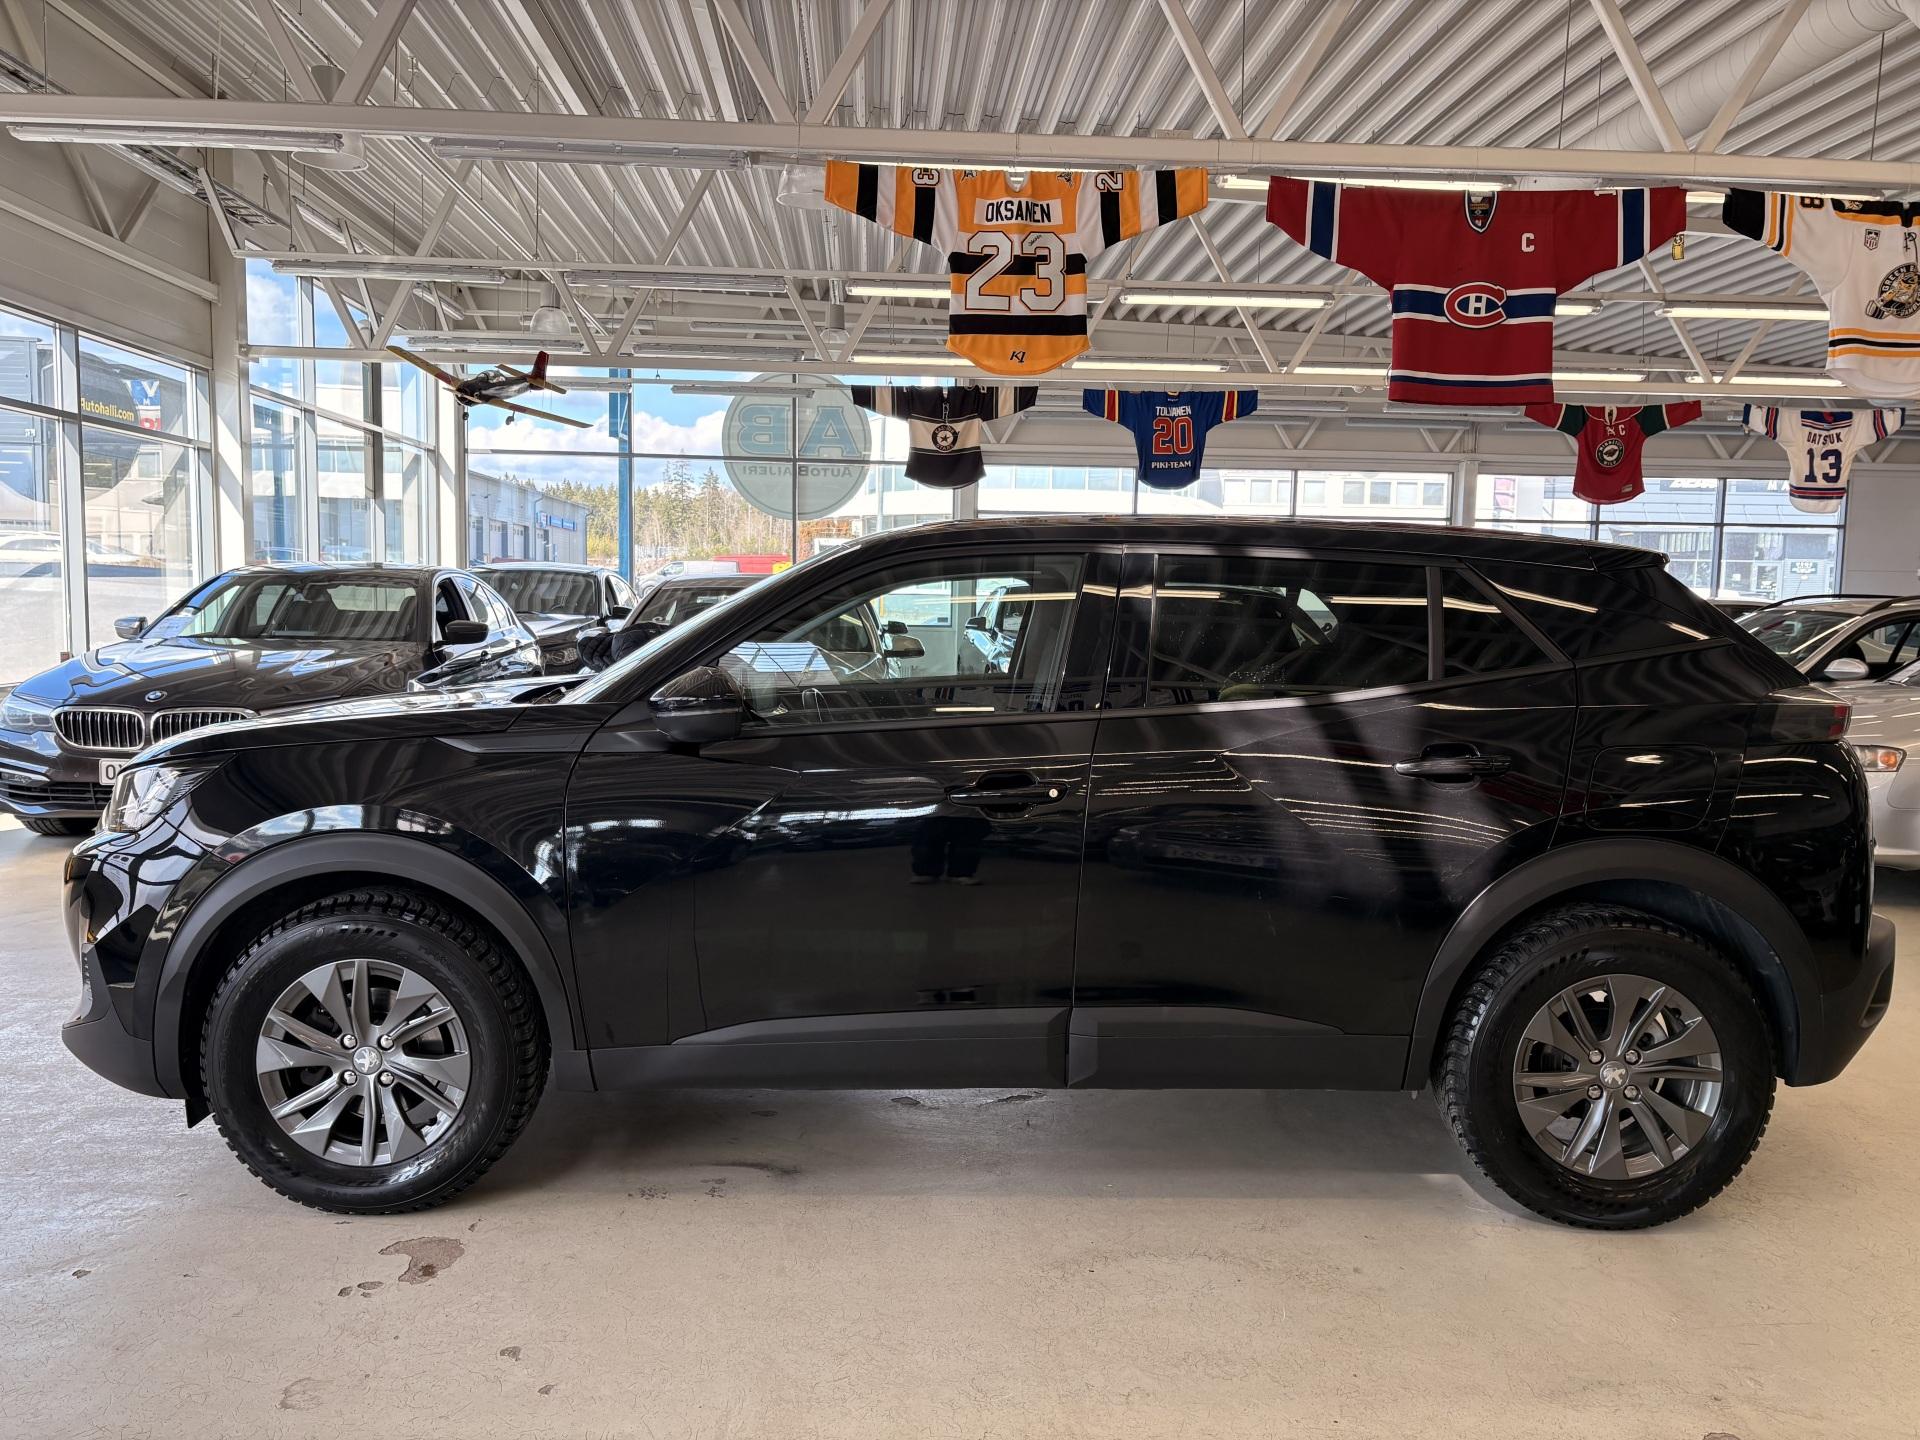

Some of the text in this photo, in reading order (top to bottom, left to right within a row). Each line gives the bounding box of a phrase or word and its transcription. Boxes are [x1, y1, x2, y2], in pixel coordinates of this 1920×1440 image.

[985, 200, 1052, 223] OKSANEN
[1521, 232, 1535, 253] C
[965, 231, 1066, 311] 23
[1155, 405, 1192, 417] TOLVANEN
[1152, 416, 1194, 455] 20
[1806, 431, 1843, 446] DATSUK
[1804, 447, 1843, 484] 13
